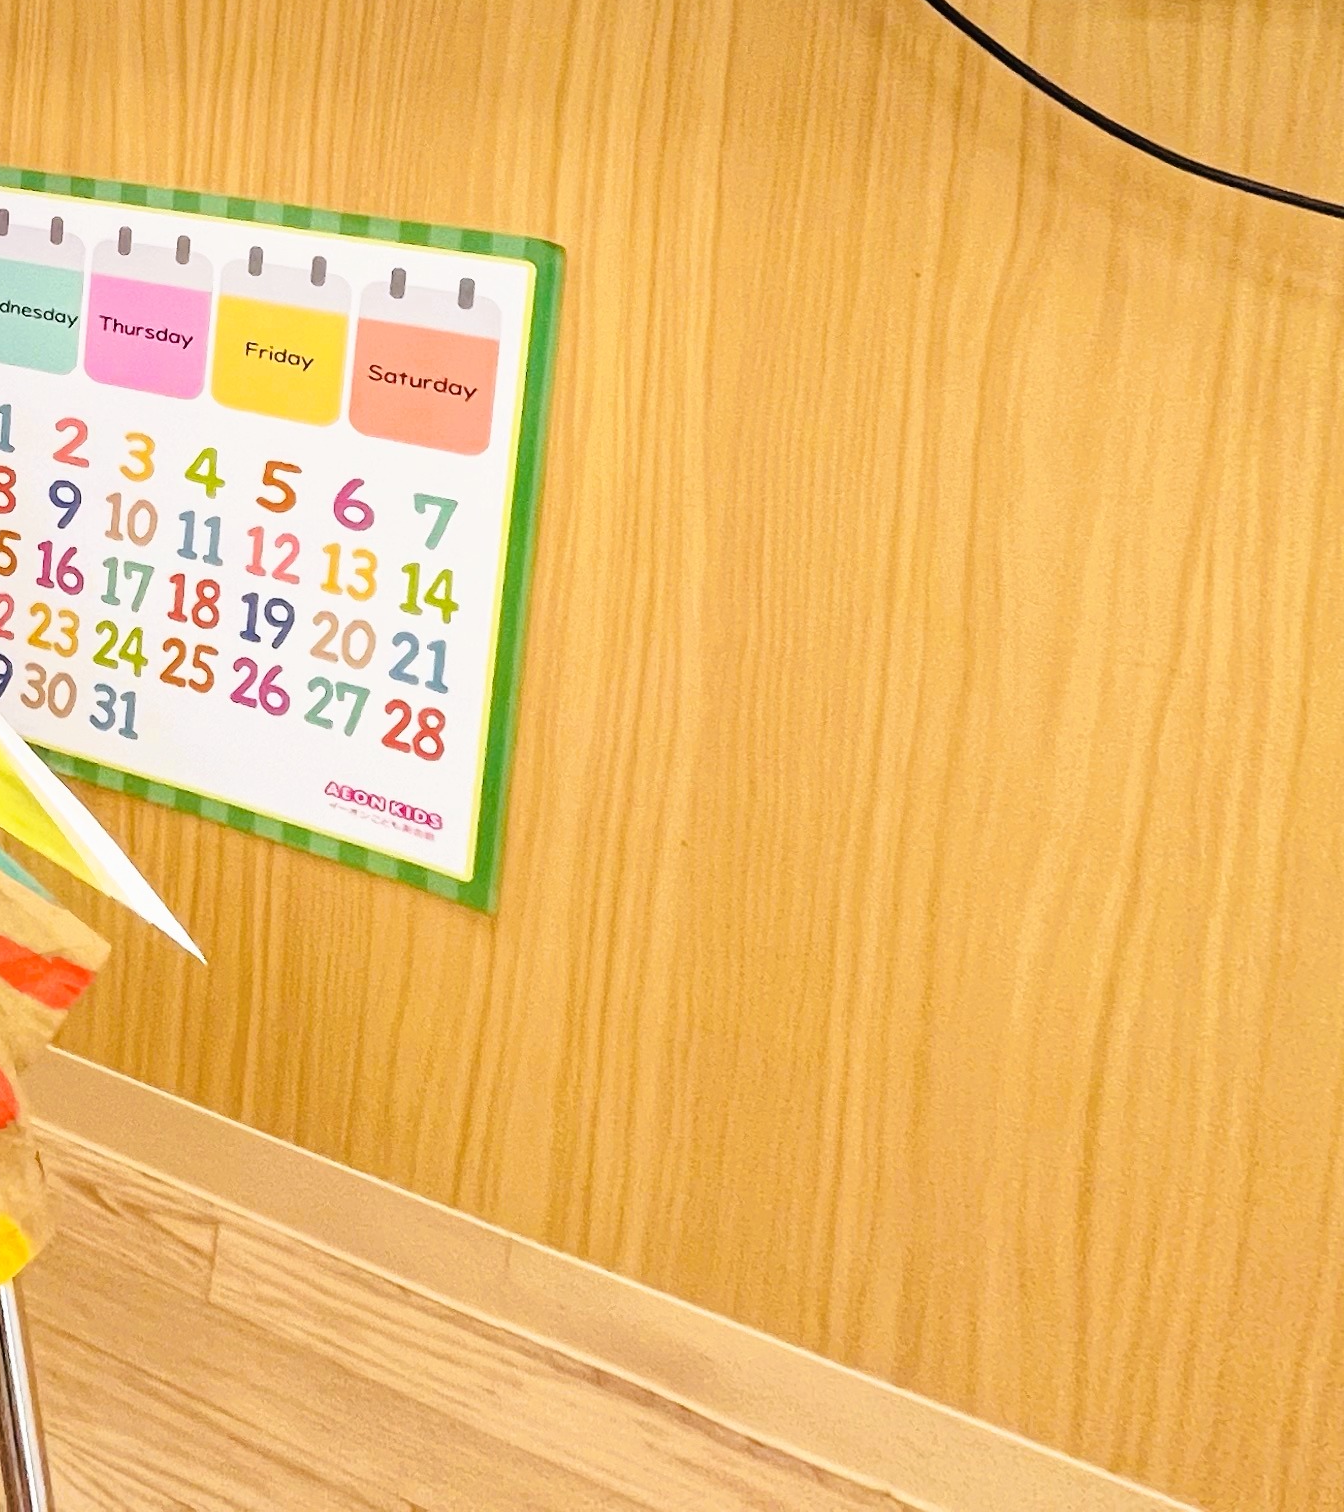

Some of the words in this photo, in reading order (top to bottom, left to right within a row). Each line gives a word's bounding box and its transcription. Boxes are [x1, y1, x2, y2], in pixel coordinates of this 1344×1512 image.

[98, 314, 194, 350] Thursday
[245, 341, 315, 372] Friday
[367, 364, 478, 402] Saturday
[53, 417, 90, 468] 2
[119, 432, 156, 482] 3
[185, 447, 226, 498] 4
[256, 460, 302, 513] 5
[333, 478, 374, 531] 6
[414, 493, 459, 549] 7
[35, 539, 85, 596] 16
[101, 556, 155, 612] 17
[167, 572, 221, 629] 18
[240, 591, 296, 649] 19
[310, 611, 376, 669] 20
[389, 631, 448, 694] 21
[48, 479, 82, 529] 9
[104, 492, 158, 546] 10
[177, 510, 224, 566] 11
[245, 525, 300, 584] 12
[320, 543, 377, 601] 13
[399, 563, 459, 624] 14
[19, 662, 78, 719] 30
[89, 683, 139, 740] 31
[27, 602, 80, 657] 23
[93, 619, 148, 677] 24
[160, 637, 220, 694] 25
[229, 656, 291, 716] 26
[303, 676, 371, 736] 27
[381, 699, 446, 761] 28
[324, 781, 387, 812] AEON
[389, 799, 444, 830] KIDS
